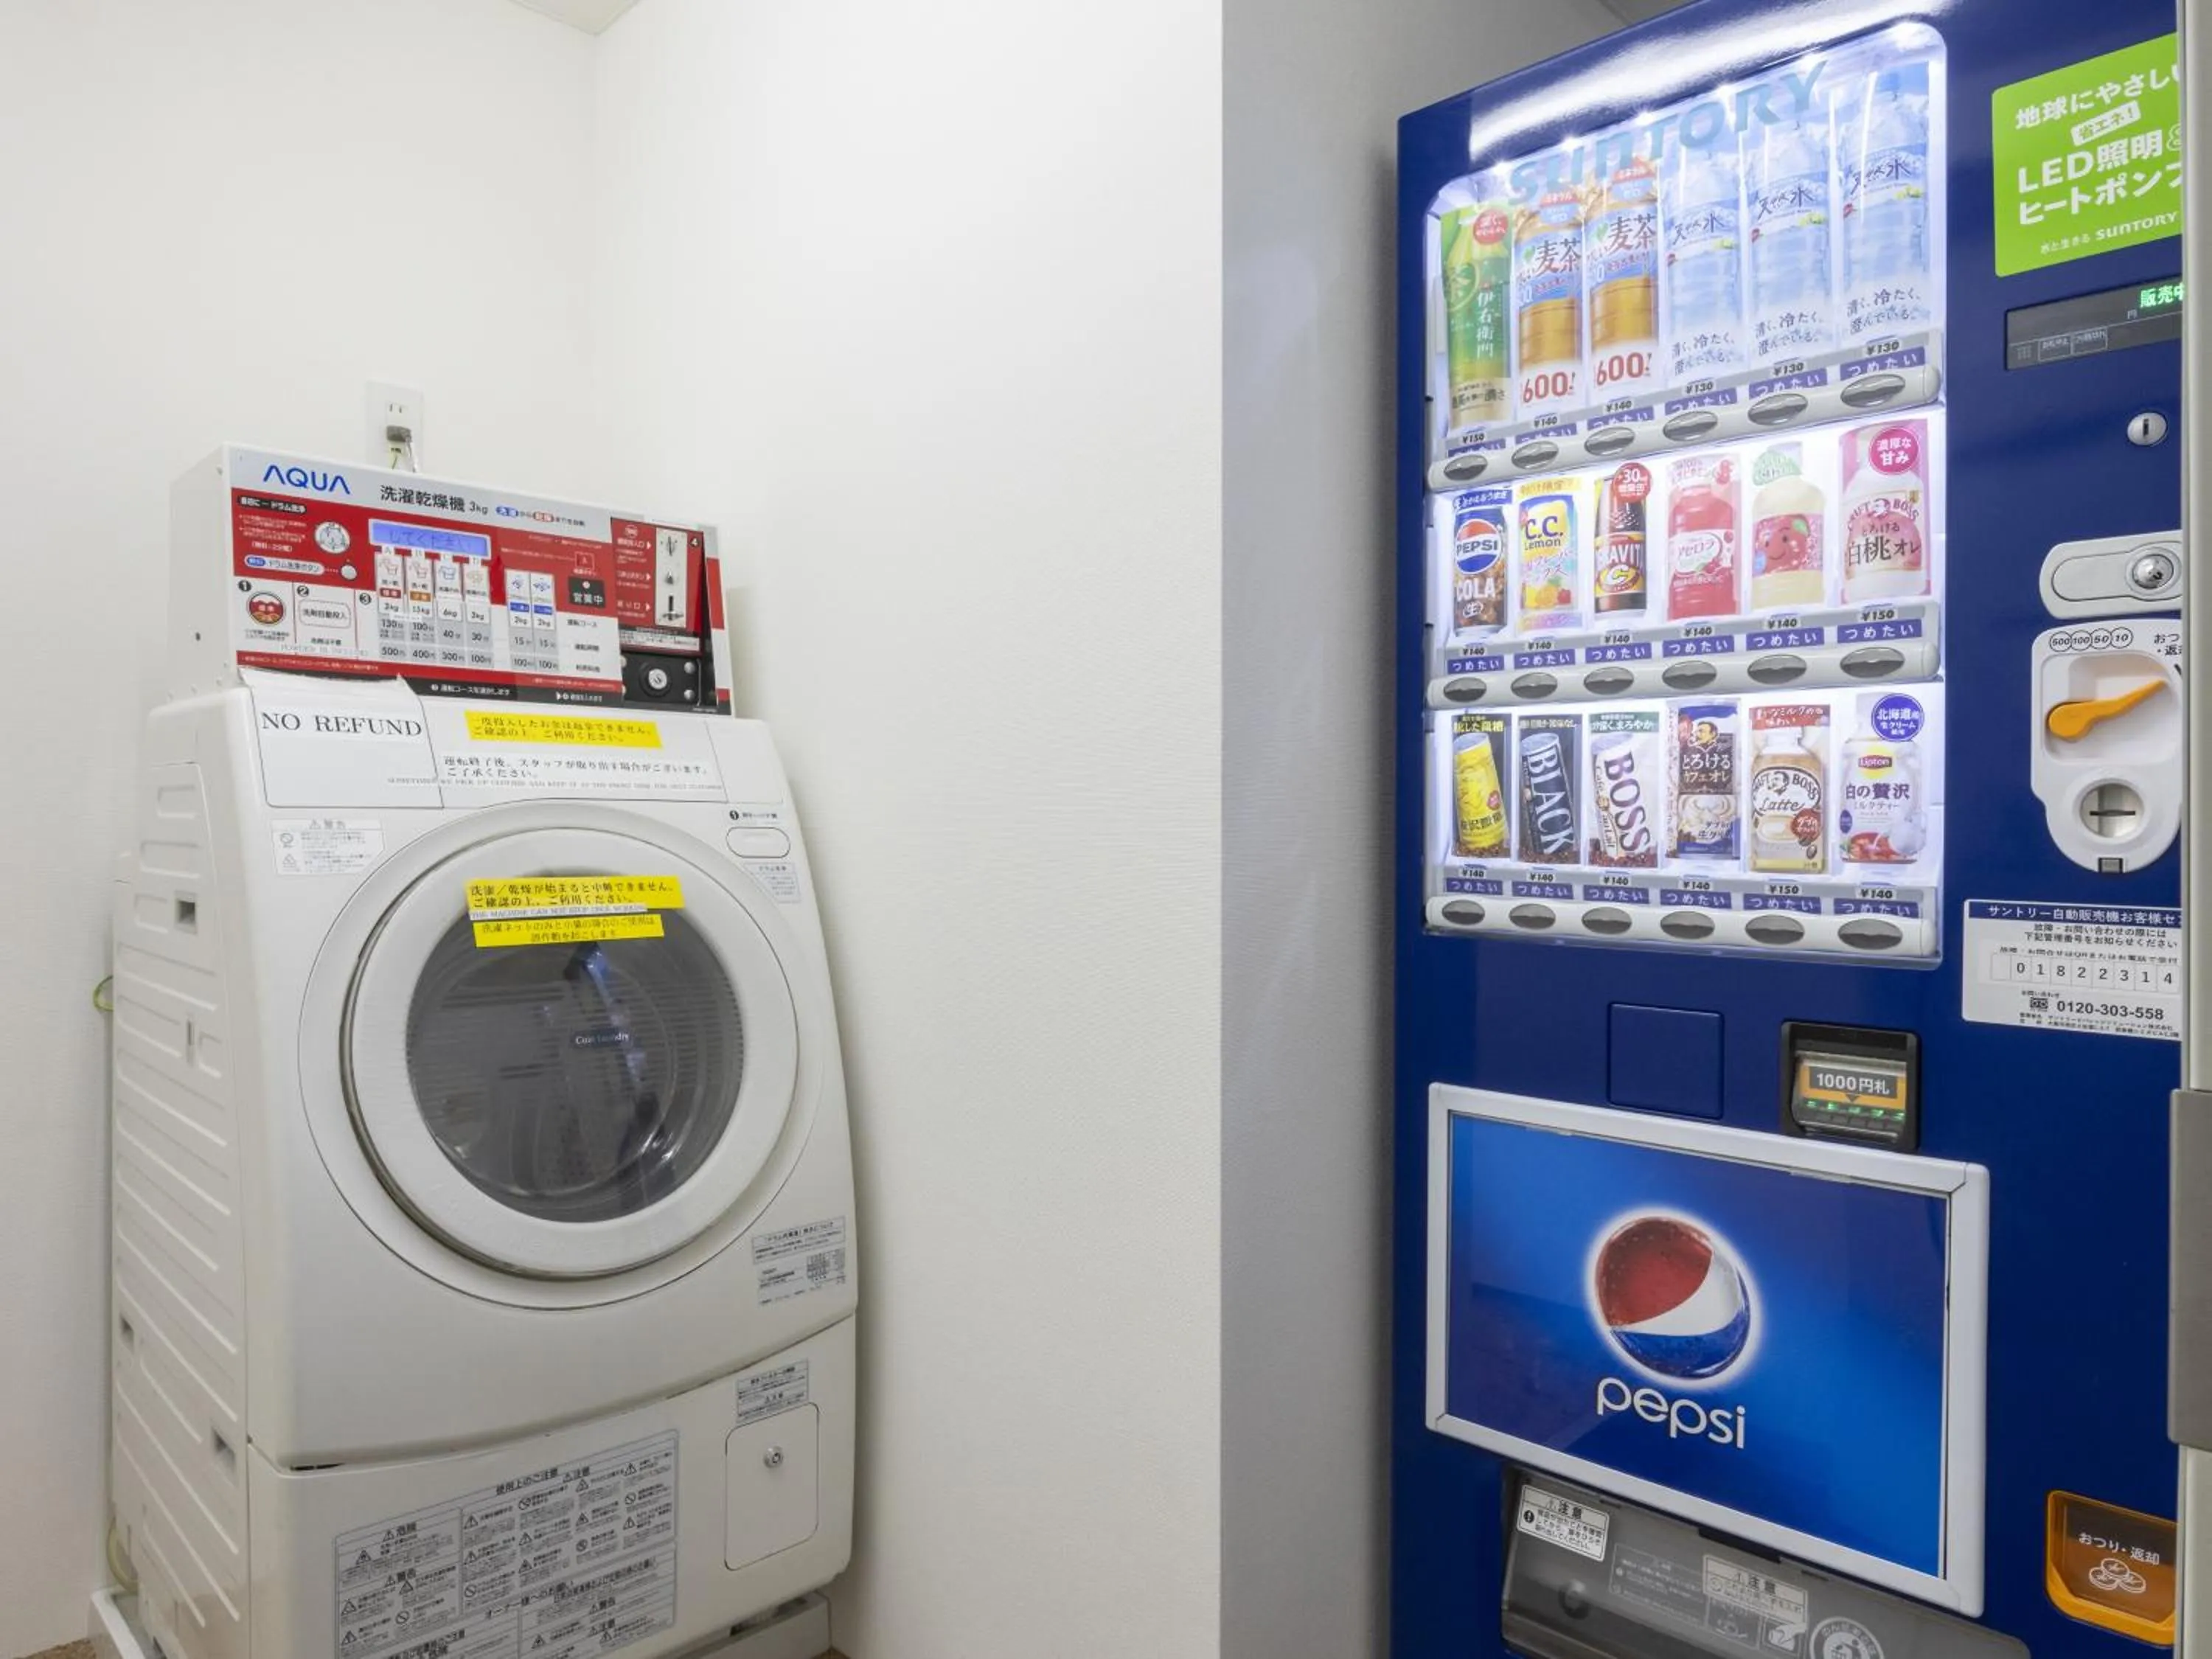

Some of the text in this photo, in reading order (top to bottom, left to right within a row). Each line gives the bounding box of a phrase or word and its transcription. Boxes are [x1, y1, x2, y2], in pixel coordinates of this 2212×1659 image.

[1509, 60, 1827, 205] SUNTORY
[2096, 211, 2178, 240] SUNTORY
[1608, 214, 1657, 255] 麦茶
[1537, 238, 1582, 276] 麦茶
[1477, 291, 1494, 358] 伊右衛門
[1866, 341, 1899, 355] ¥130
[1773, 362, 1804, 376] ¥130
[1685, 381, 1713, 394] ¥130
[1877, 435, 1912, 451] 濃厚な
[1880, 451, 1910, 466] 甘み
[263, 465, 350, 495] AQUA
[380, 484, 465, 512] 洗濯乾燥機
[1526, 515, 1564, 540] C.C.
[1456, 539, 1498, 554] PEPSI
[1524, 538, 1562, 552] Lemon
[1848, 535, 1920, 566] 白桃オレ
[1457, 578, 1496, 602] COLA
[572, 592, 603, 605] 営業中
[1767, 618, 1798, 628] ¥140
[1861, 609, 1895, 622] ¥150
[1684, 625, 1712, 636] ¥140
[1846, 624, 1914, 640] つめたい
[1604, 634, 1630, 644] ¥140
[1753, 632, 1818, 647] つめたい
[2052, 633, 2128, 646] 500 100 50 10
[1592, 647, 1646, 661] つめたい
[1669, 639, 1728, 655] つめたい
[1453, 659, 1499, 671] つめたい
[1519, 653, 1570, 667] つめたい
[262, 712, 422, 736] NO REFUND
[1681, 753, 1731, 770] とろける
[1860, 757, 1890, 768] Lipton
[1846, 782, 1910, 800] 白の贅沢
[1528, 744, 1574, 855] BLACK
[1604, 749, 1651, 852] BOSS
[1760, 798, 1804, 812] Latte
[1450, 880, 1498, 892] つめたい
[1603, 876, 1629, 886] ¥140
[1683, 881, 1711, 891] ¥140
[1518, 884, 1569, 897] つめたい
[1588, 888, 1643, 900] つめたい
[1769, 885, 1799, 895] ¥150
[1860, 888, 1893, 899] ¥140
[1666, 893, 1725, 905] つめたい
[1750, 897, 1814, 911] つめたい
[1841, 902, 1912, 917] つめたい
[1989, 905, 2182, 925] サントリー自動販売機お客様セ
[2034, 923, 2166, 937] 故障・お問い合わせの際には
[2025, 931, 2178, 948] 下記管理番号をお知らせください
[2056, 1000, 2165, 1020] 0120-303-558
[1816, 1073, 1890, 1095] 1000円札
[1596, 1377, 1747, 1450] pepsi
[2078, 1532, 2160, 1565] おつり・返却
